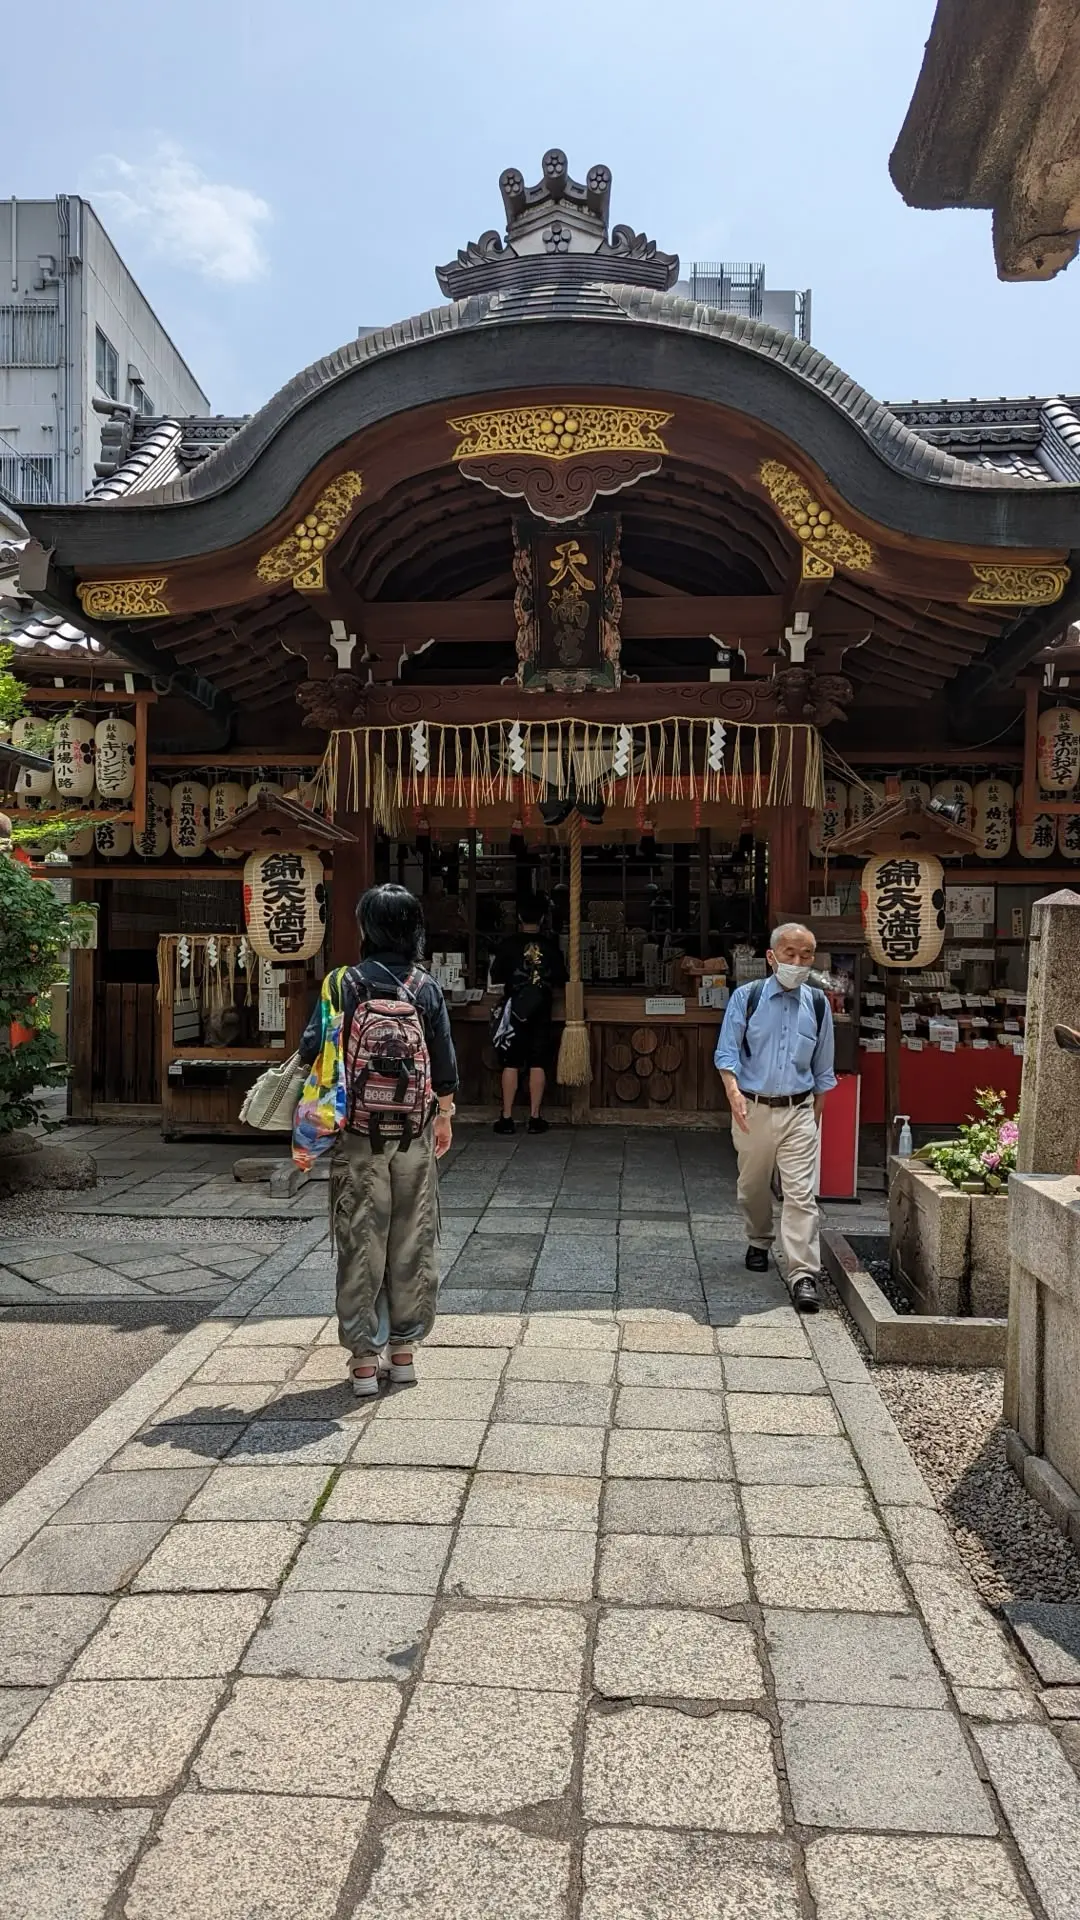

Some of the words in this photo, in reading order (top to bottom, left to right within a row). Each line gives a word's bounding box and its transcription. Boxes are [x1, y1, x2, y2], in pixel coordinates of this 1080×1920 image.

[57, 740, 74, 788] 市場小路
[102, 741, 121, 791] キリンシティ
[260, 853, 306, 954] 錦天満宮
[876, 859, 922, 961] 錦天満宮
